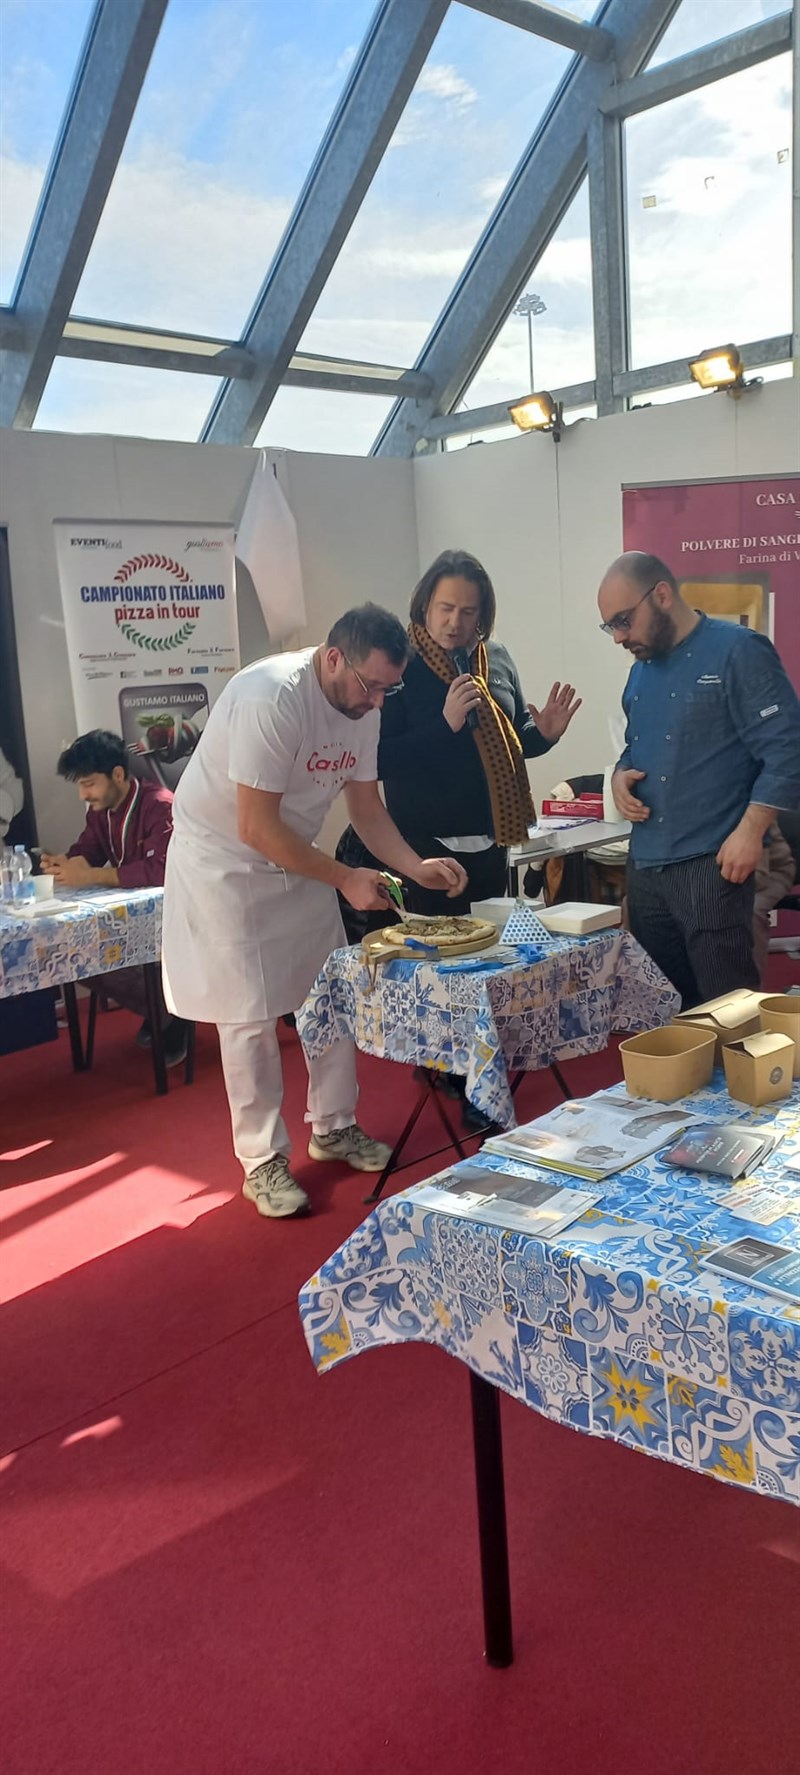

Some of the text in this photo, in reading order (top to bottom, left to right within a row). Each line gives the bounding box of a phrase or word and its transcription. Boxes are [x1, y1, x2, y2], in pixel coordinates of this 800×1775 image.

[756, 492, 796, 506] CASA
[681, 538, 740, 552] POLVERE
[743, 537, 757, 548] DI
[739, 552, 776, 564] Farina
[779, 550, 791, 562] di
[80, 584, 225, 603] CAMPIONATO ITALIANO
[114, 603, 200, 625] pizza in tour
[124, 693, 205, 707] GUSTIAMO ITALIANO
